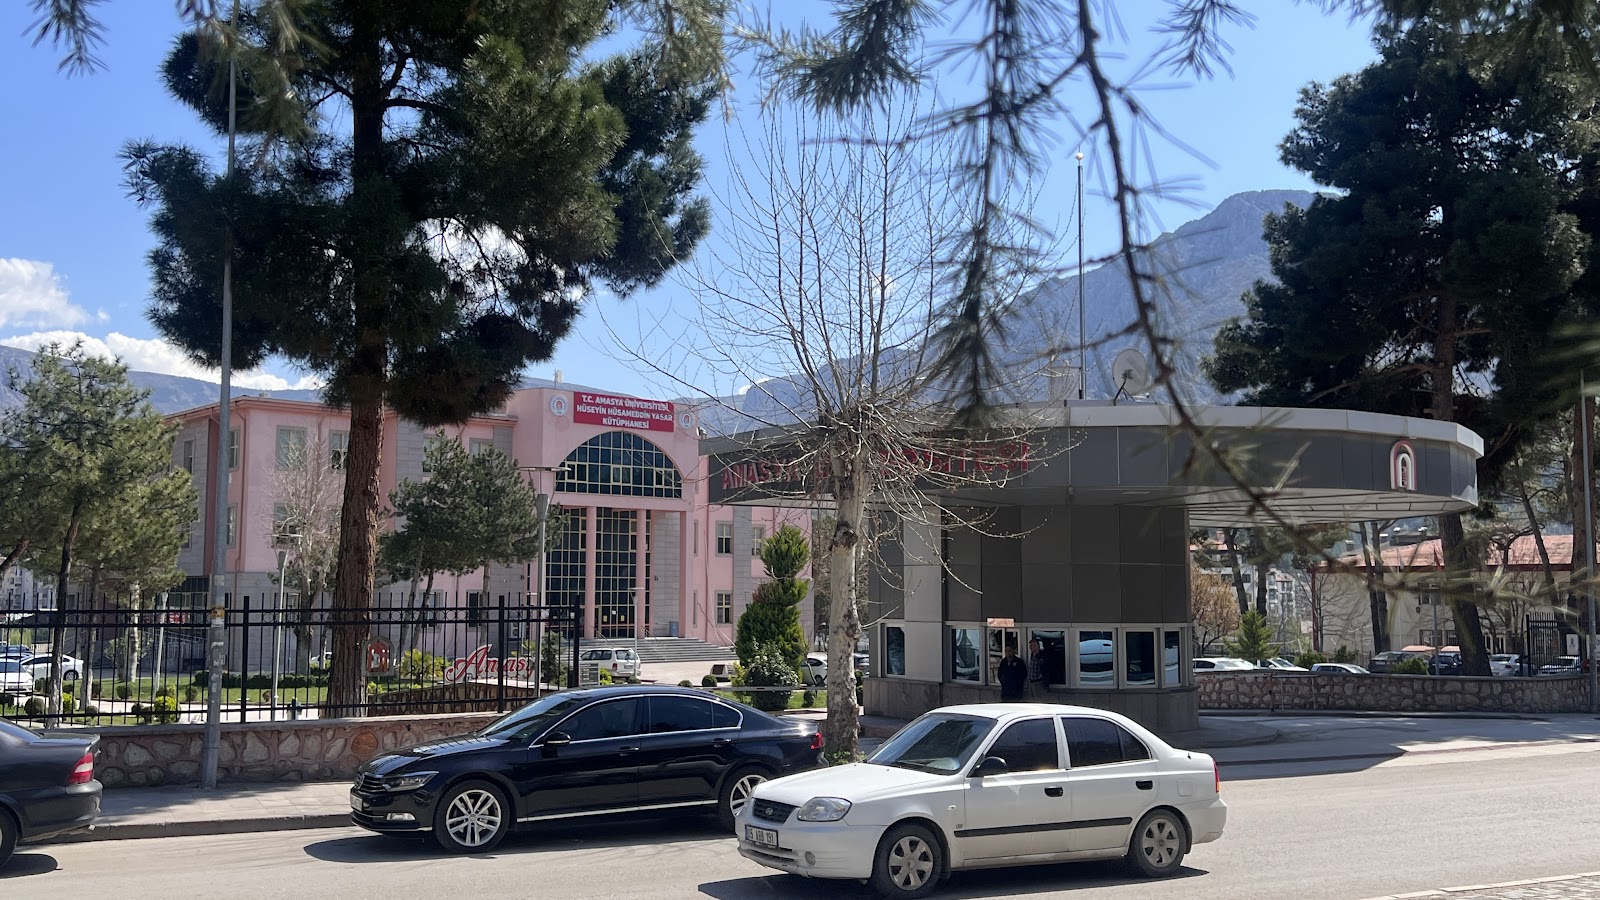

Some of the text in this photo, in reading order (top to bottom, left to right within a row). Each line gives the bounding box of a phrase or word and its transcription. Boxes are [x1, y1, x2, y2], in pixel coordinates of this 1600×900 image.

[582, 394, 595, 403] T.C.
[595, 396, 624, 406] AMASYA
[576, 403, 607, 415] HÜSEYİN
[608, 406, 650, 419] HÜSAMEDDİN
[602, 417, 650, 429] KÜTÜPHANESİ
